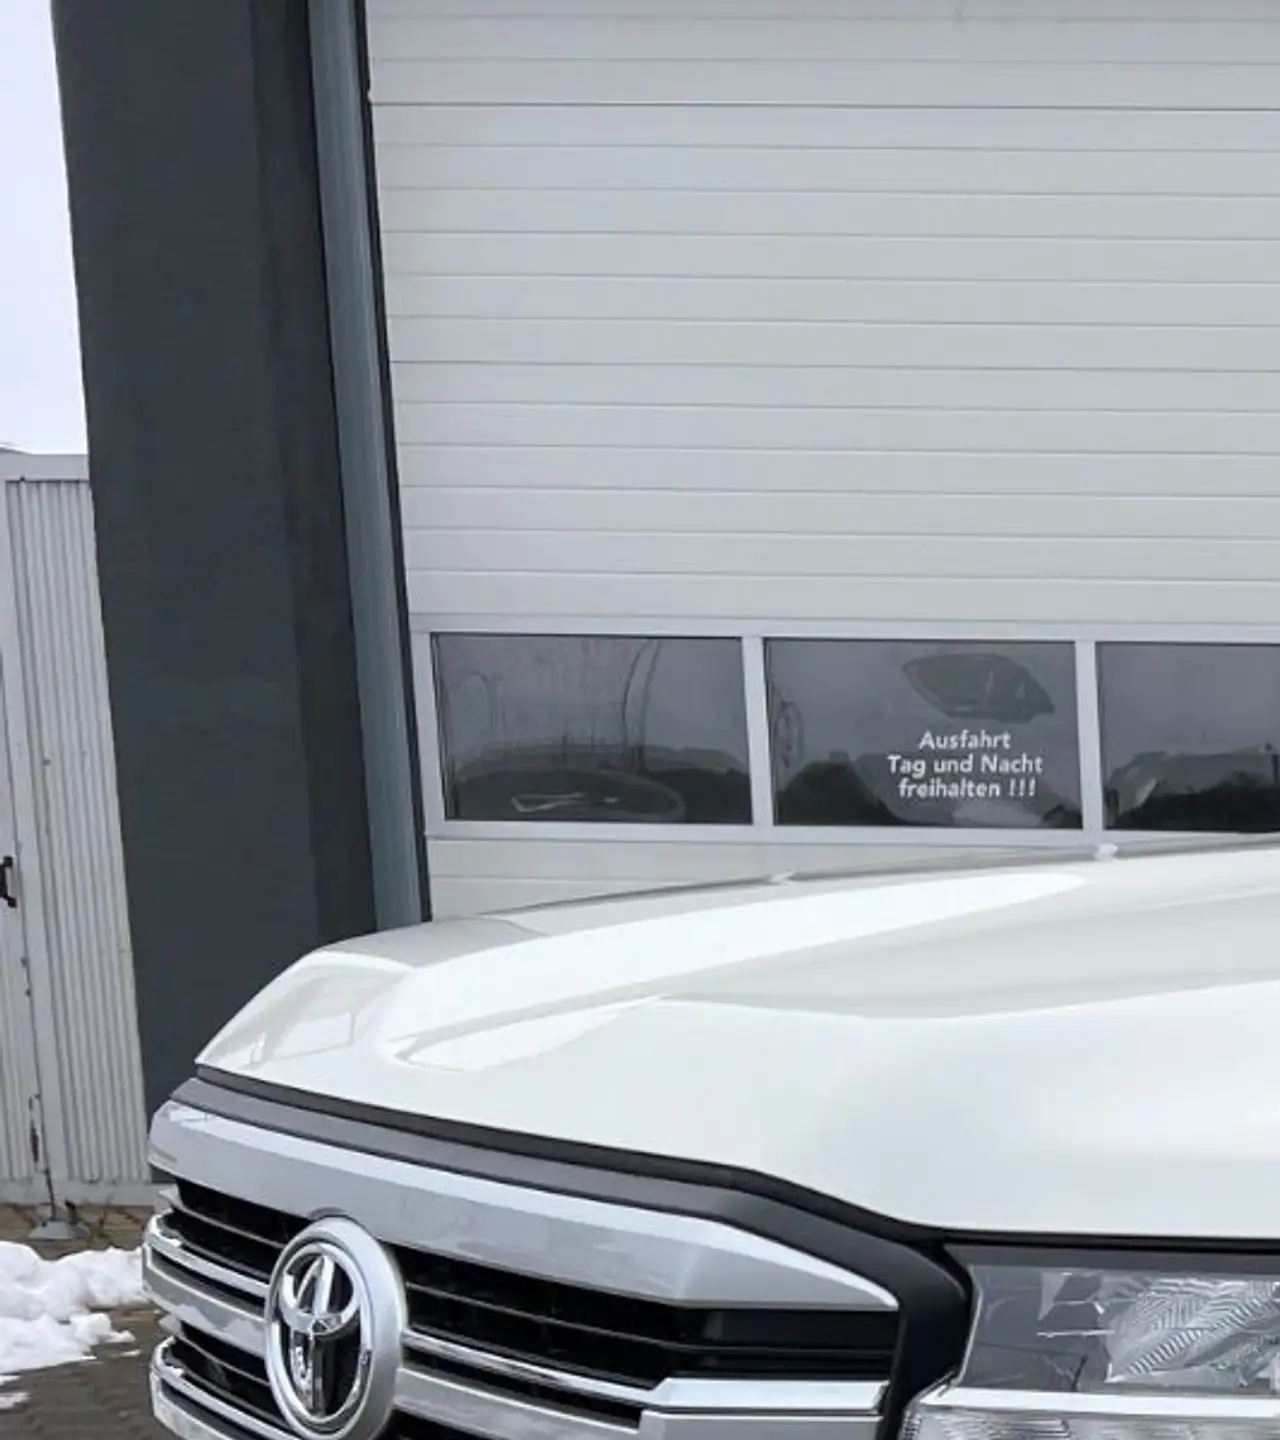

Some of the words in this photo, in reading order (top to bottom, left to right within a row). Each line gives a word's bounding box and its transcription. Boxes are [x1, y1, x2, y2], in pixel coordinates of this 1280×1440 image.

[919, 729, 1011, 749] Ausfahrt
[887, 754, 926, 779] Tag
[934, 753, 973, 773] und
[980, 752, 1043, 774] Nacht
[898, 777, 1000, 797] freihalten
[1009, 777, 1036, 797] !!!
